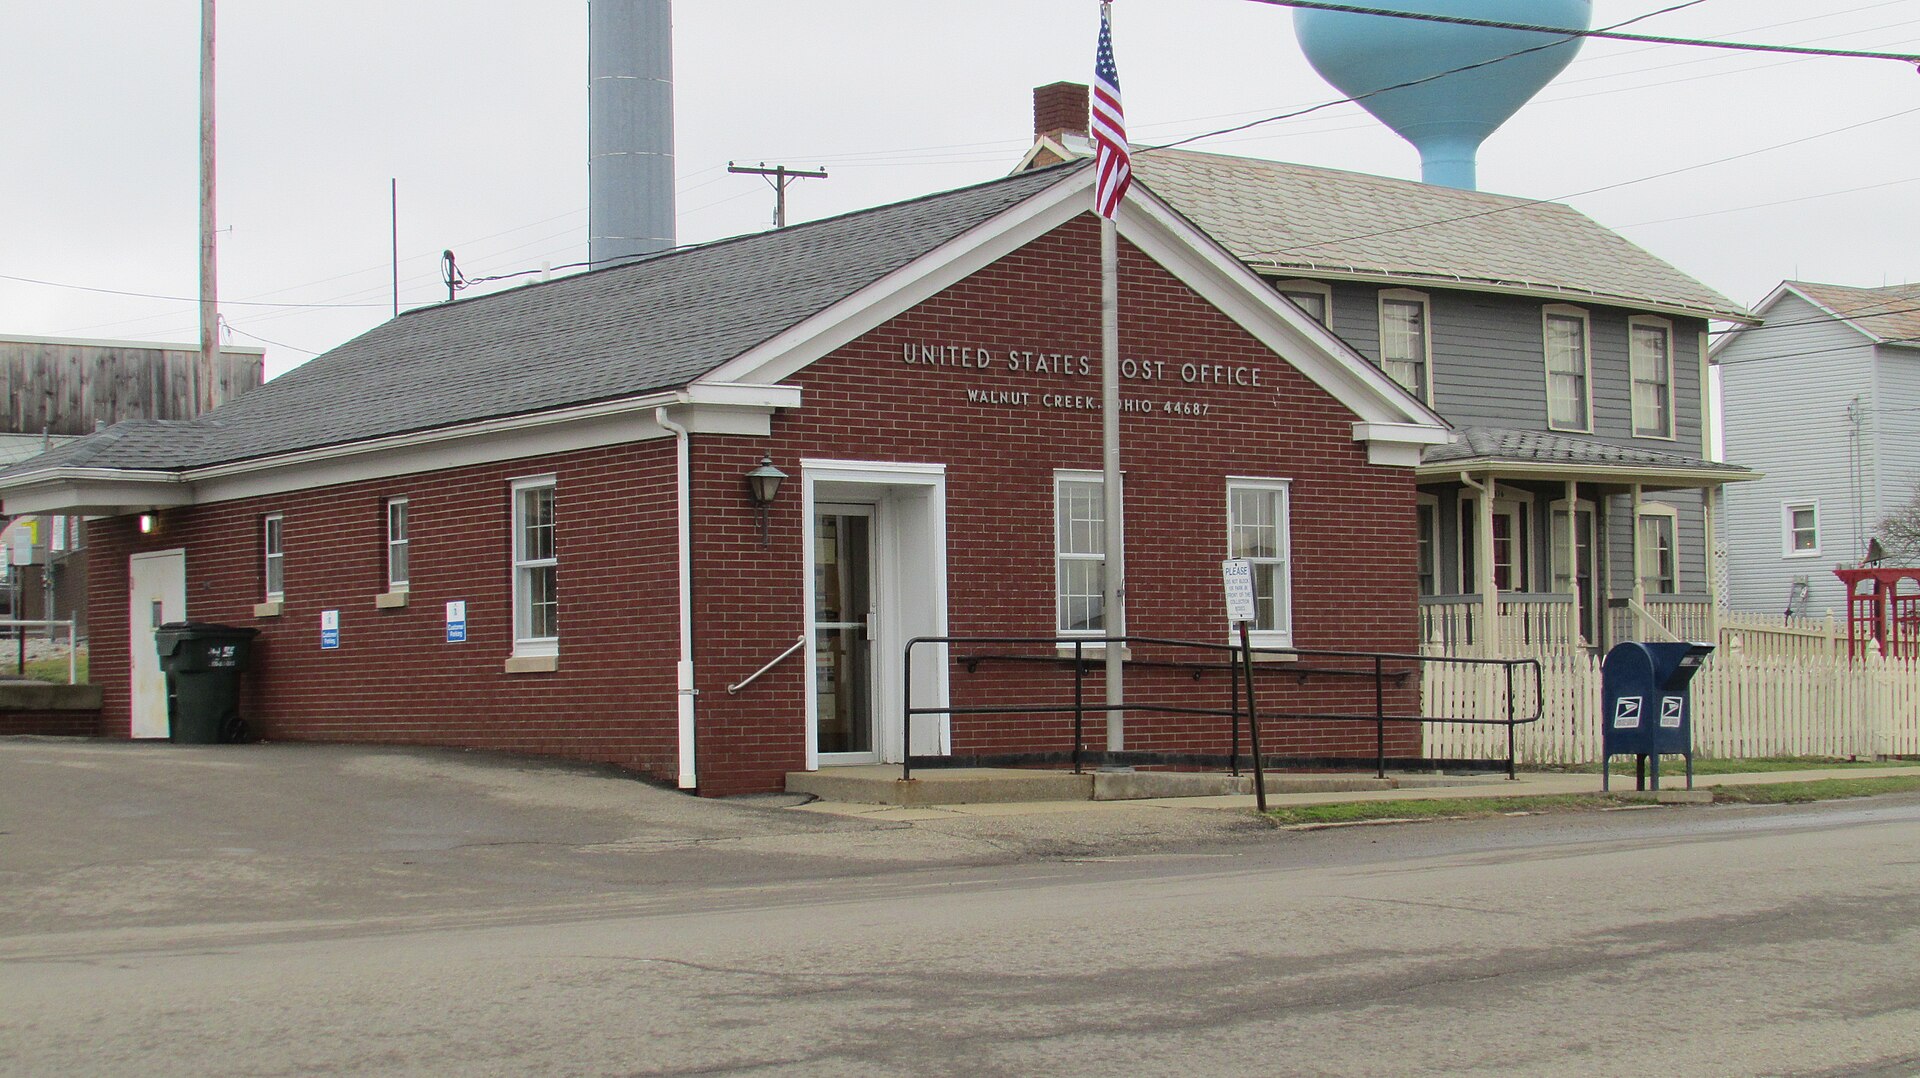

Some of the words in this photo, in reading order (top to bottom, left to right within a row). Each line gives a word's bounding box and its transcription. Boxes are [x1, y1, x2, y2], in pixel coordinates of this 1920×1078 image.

[903, 343, 990, 369] UNITED
[1008, 350, 1090, 375] STATES
[1121, 358, 1165, 380] OST
[1181, 362, 1261, 387] OFFICE
[967, 388, 1030, 406] WALNUT
[1163, 401, 1209, 416] 44687
[1225, 566, 1248, 576] PLEASE
